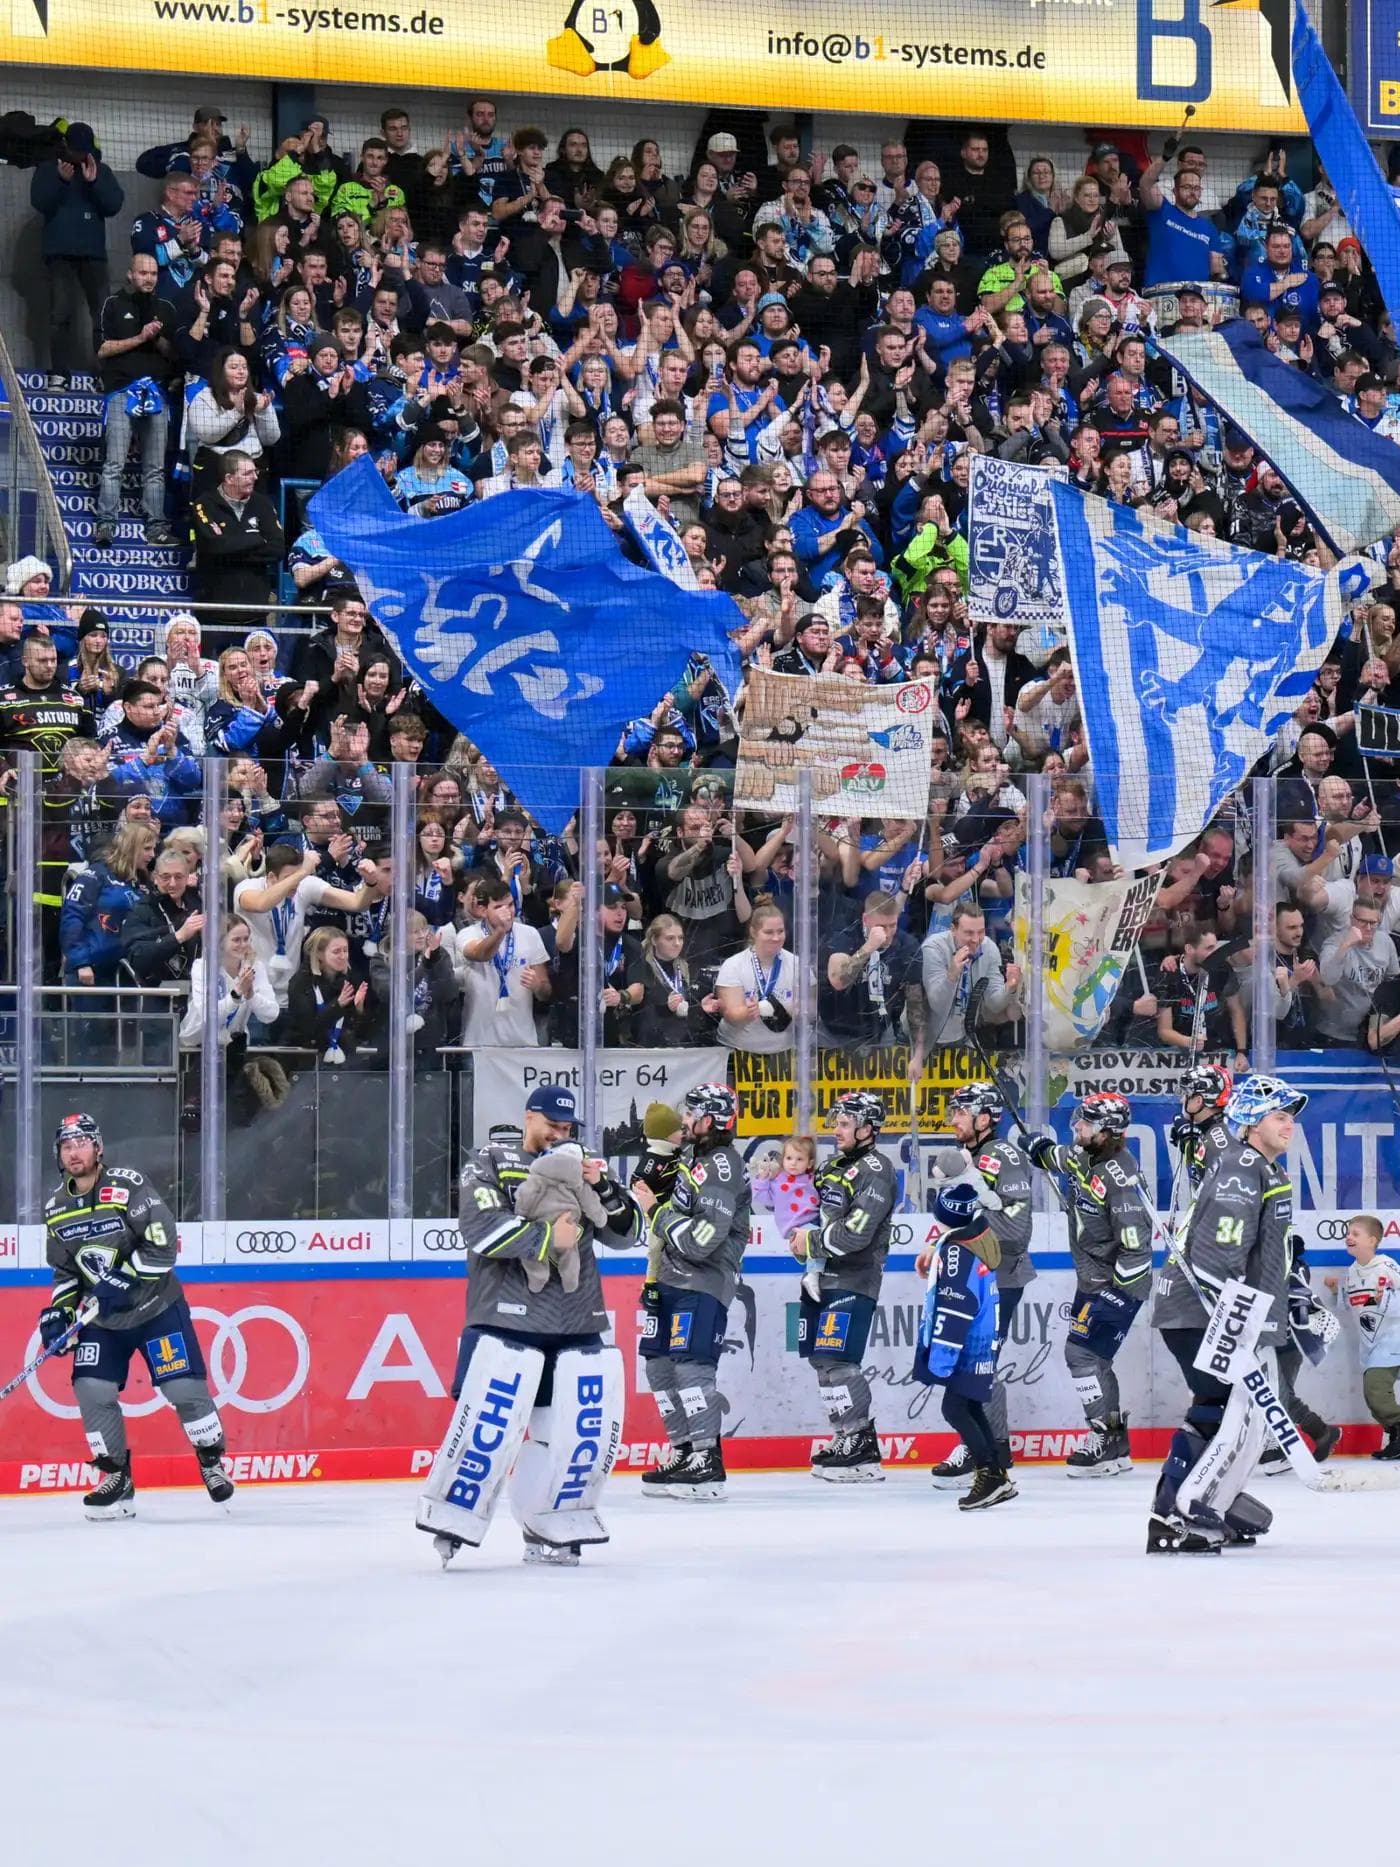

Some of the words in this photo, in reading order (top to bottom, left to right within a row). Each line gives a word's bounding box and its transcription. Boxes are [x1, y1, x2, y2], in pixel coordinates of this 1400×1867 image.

[767, 30, 1046, 70] info@b1-systems.de
[71, 547, 181, 567] NORDBRÄU
[78, 571, 190, 593] NORDBRÄU
[36, 711, 79, 725] SATURN
[523, 1066, 628, 1088] Panter
[636, 1064, 668, 1087] 64
[1073, 1078, 1180, 1097] INGOLST
[738, 1083, 781, 1119] FÜR
[845, 1208, 872, 1235] 21
[1215, 1215, 1245, 1246] 34
[308, 1231, 372, 1252] Audi
[1205, 1300, 1228, 1346] BAUER
[1209, 1292, 1257, 1374] BÜCHL
[155, 1358, 187, 1376] BAUER
[1242, 1369, 1300, 1456] BÜCHL
[445, 1372, 521, 1511] BÜCHL
[446, 1404, 472, 1460] BAUER
[552, 1373, 604, 1511] BÜCHL
[600, 1419, 620, 1475] BAUER
[20, 1462, 101, 1489] PENN
